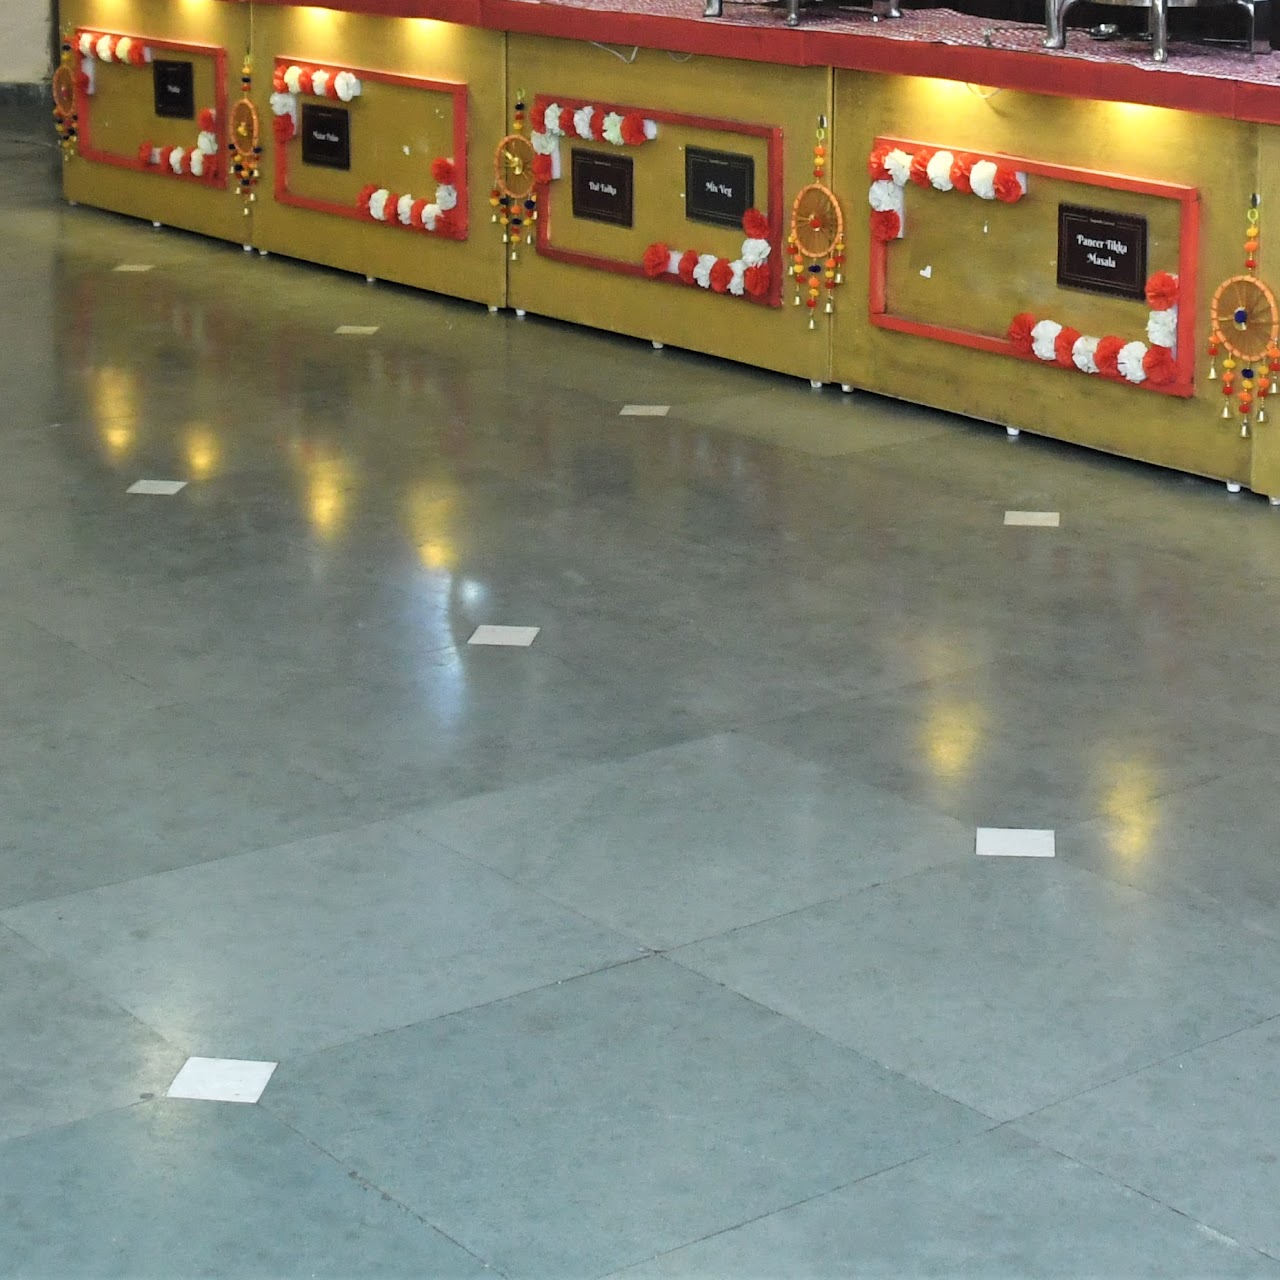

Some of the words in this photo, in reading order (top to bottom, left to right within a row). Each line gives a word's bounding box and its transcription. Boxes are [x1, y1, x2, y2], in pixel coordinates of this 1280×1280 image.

[1076, 234, 1104, 249] Paneer
[1105, 239, 1128, 255] Tikka
[1086, 252, 1116, 268] Masala
